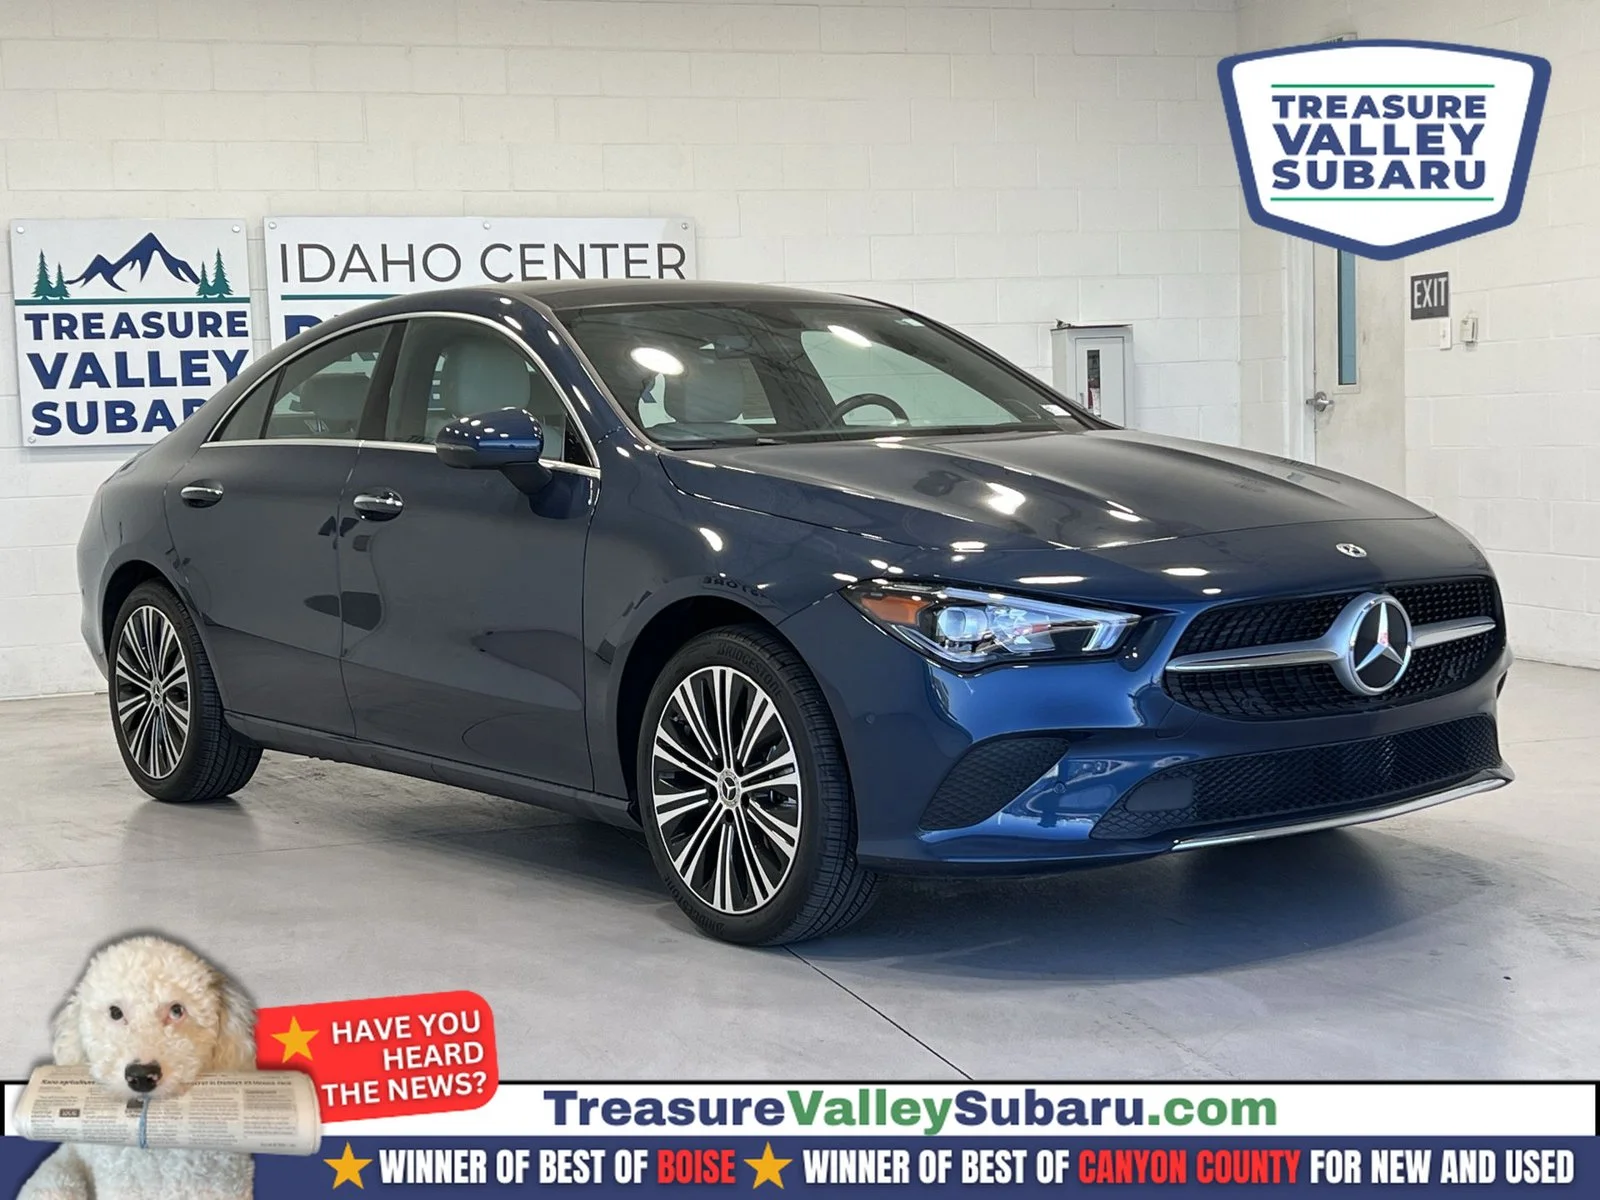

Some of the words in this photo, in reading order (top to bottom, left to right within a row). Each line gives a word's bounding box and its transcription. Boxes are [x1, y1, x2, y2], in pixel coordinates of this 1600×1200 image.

[281, 243, 461, 284] IDAHO
[481, 242, 686, 281] CENTER
[1414, 277, 1447, 309] EXIT
[24, 311, 249, 340] TREASURE
[27, 350, 249, 389] VALLEY
